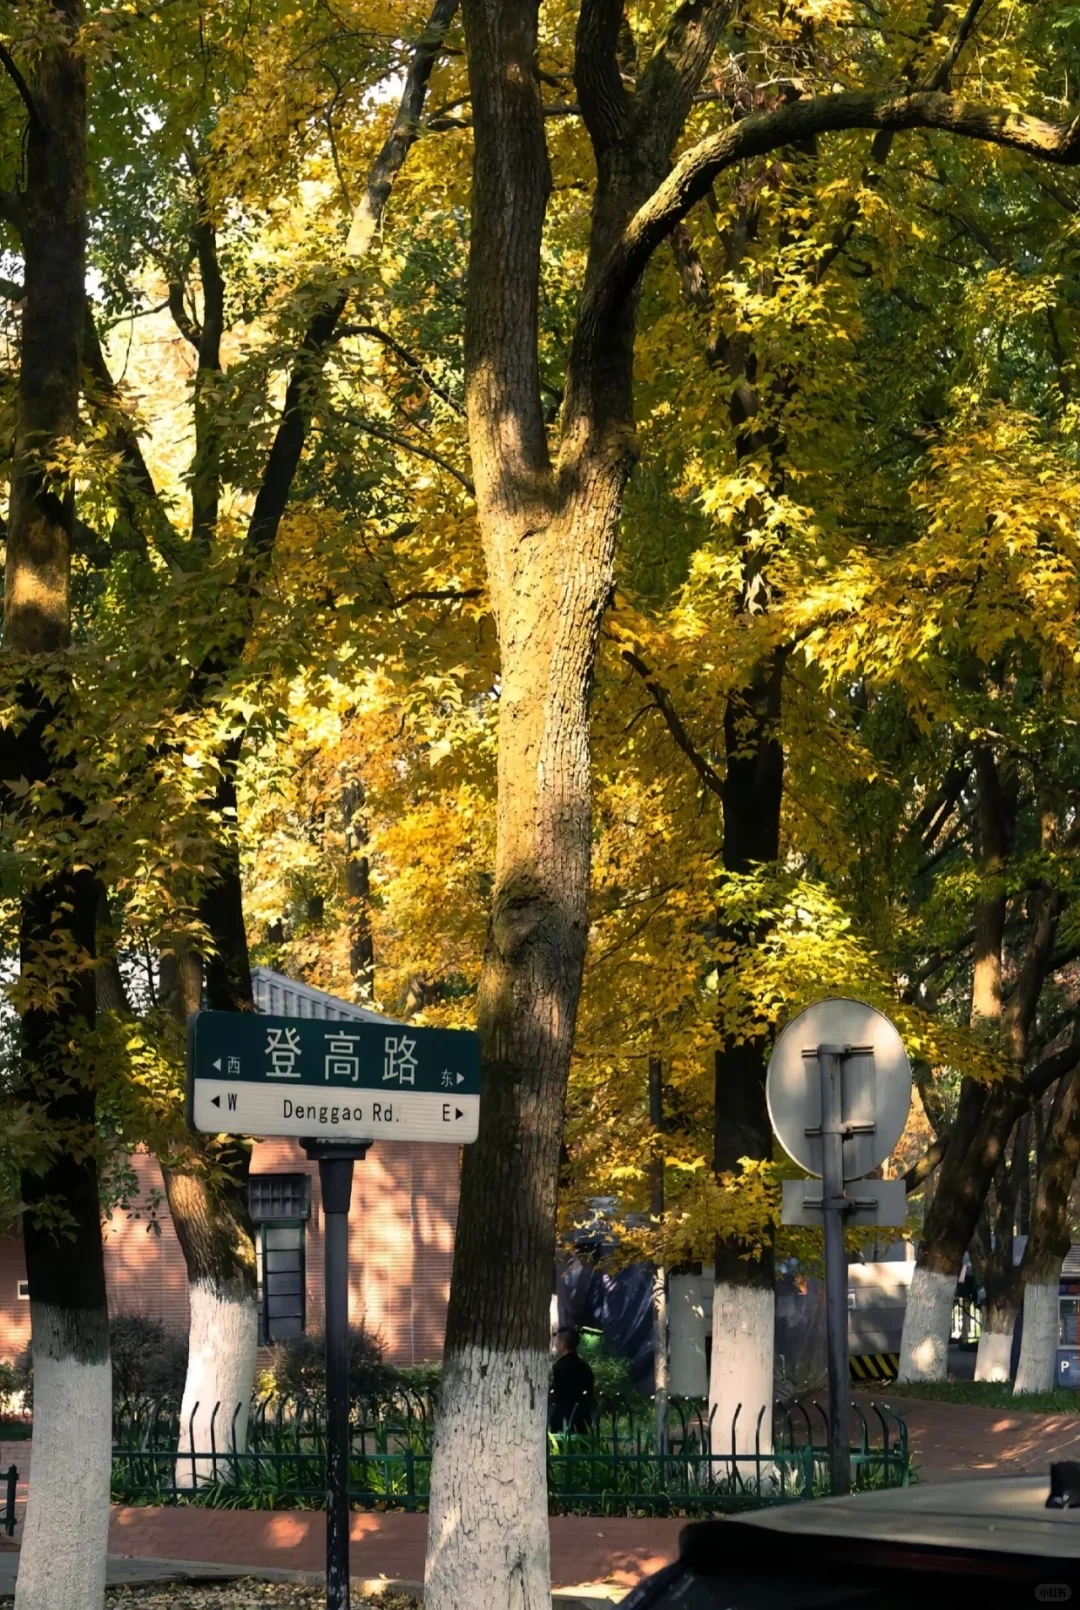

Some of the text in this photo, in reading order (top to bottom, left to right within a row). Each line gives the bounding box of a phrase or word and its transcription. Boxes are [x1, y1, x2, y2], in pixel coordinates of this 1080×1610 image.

[227, 1056, 241, 1075] 西
[264, 1027, 419, 1086] 登高路
[440, 1069, 454, 1088] 东
[227, 1093, 238, 1112] W
[283, 1099, 400, 1124] Denggao Rd.
[442, 1104, 451, 1122] E
[1061, 1361, 1070, 1373] P
